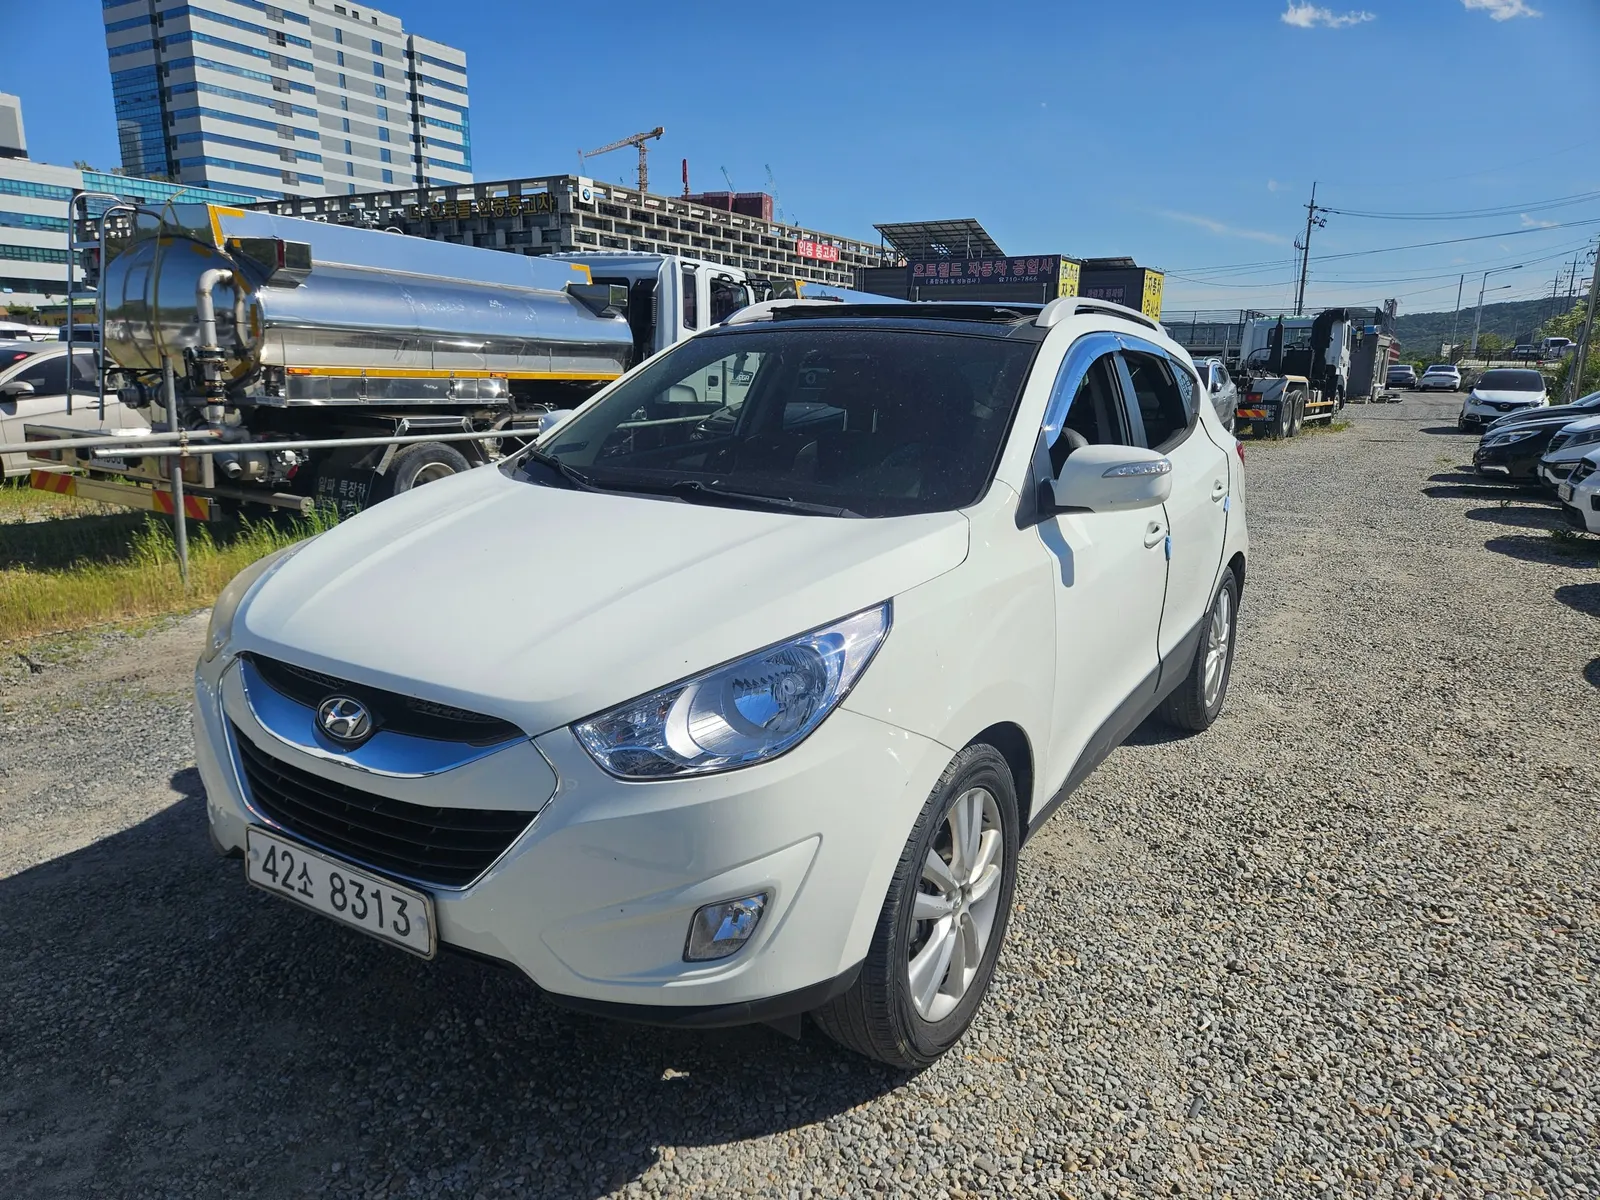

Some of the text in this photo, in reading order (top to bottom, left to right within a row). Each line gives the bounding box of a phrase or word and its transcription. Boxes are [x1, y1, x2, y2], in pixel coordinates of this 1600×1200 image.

[430, 200, 472, 220] 오토몰
[477, 193, 556, 218] 인증중고차
[798, 241, 837, 261] 인증 중고차
[912, 262, 963, 278] 오토월드
[967, 260, 1008, 278] 자동차
[1012, 257, 1055, 276] 공업사
[262, 844, 411, 938] 42소 8313
